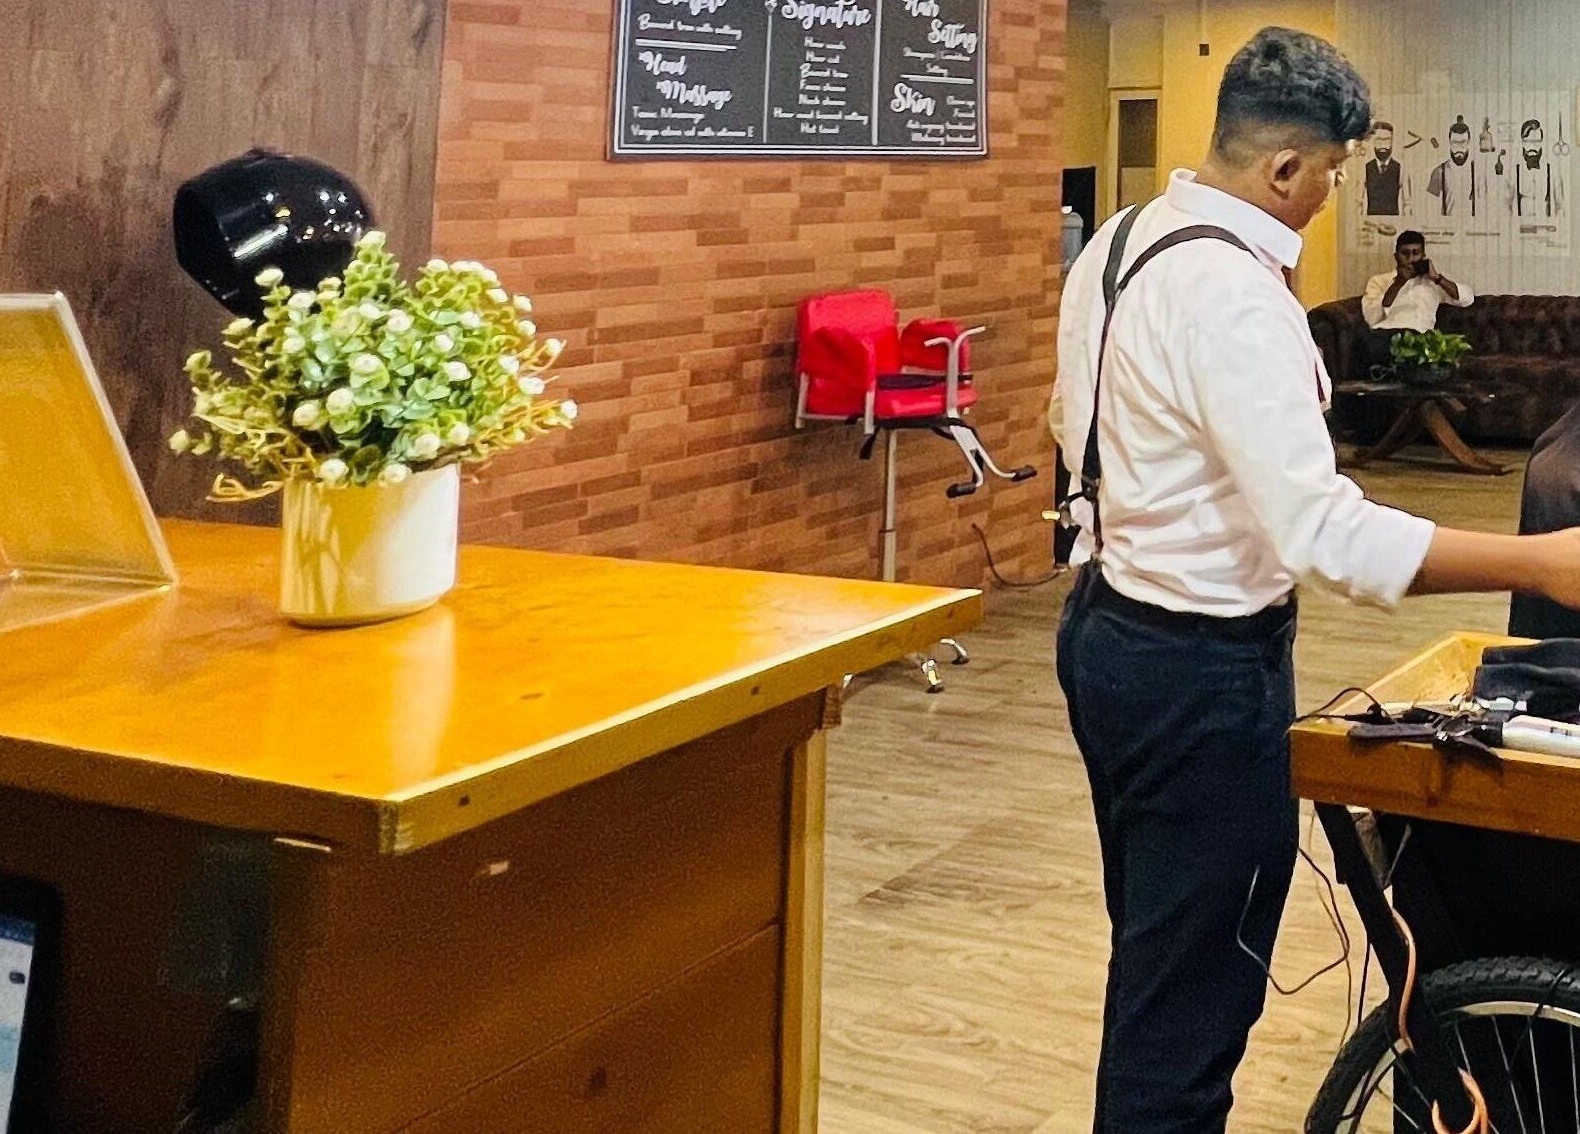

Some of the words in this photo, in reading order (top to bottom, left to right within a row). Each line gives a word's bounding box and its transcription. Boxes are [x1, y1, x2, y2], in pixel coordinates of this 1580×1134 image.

[928, 19, 978, 54] Setting
[638, 51, 686, 75] Head
[656, 80, 732, 110] Massage
[891, 83, 936, 116] Skin
